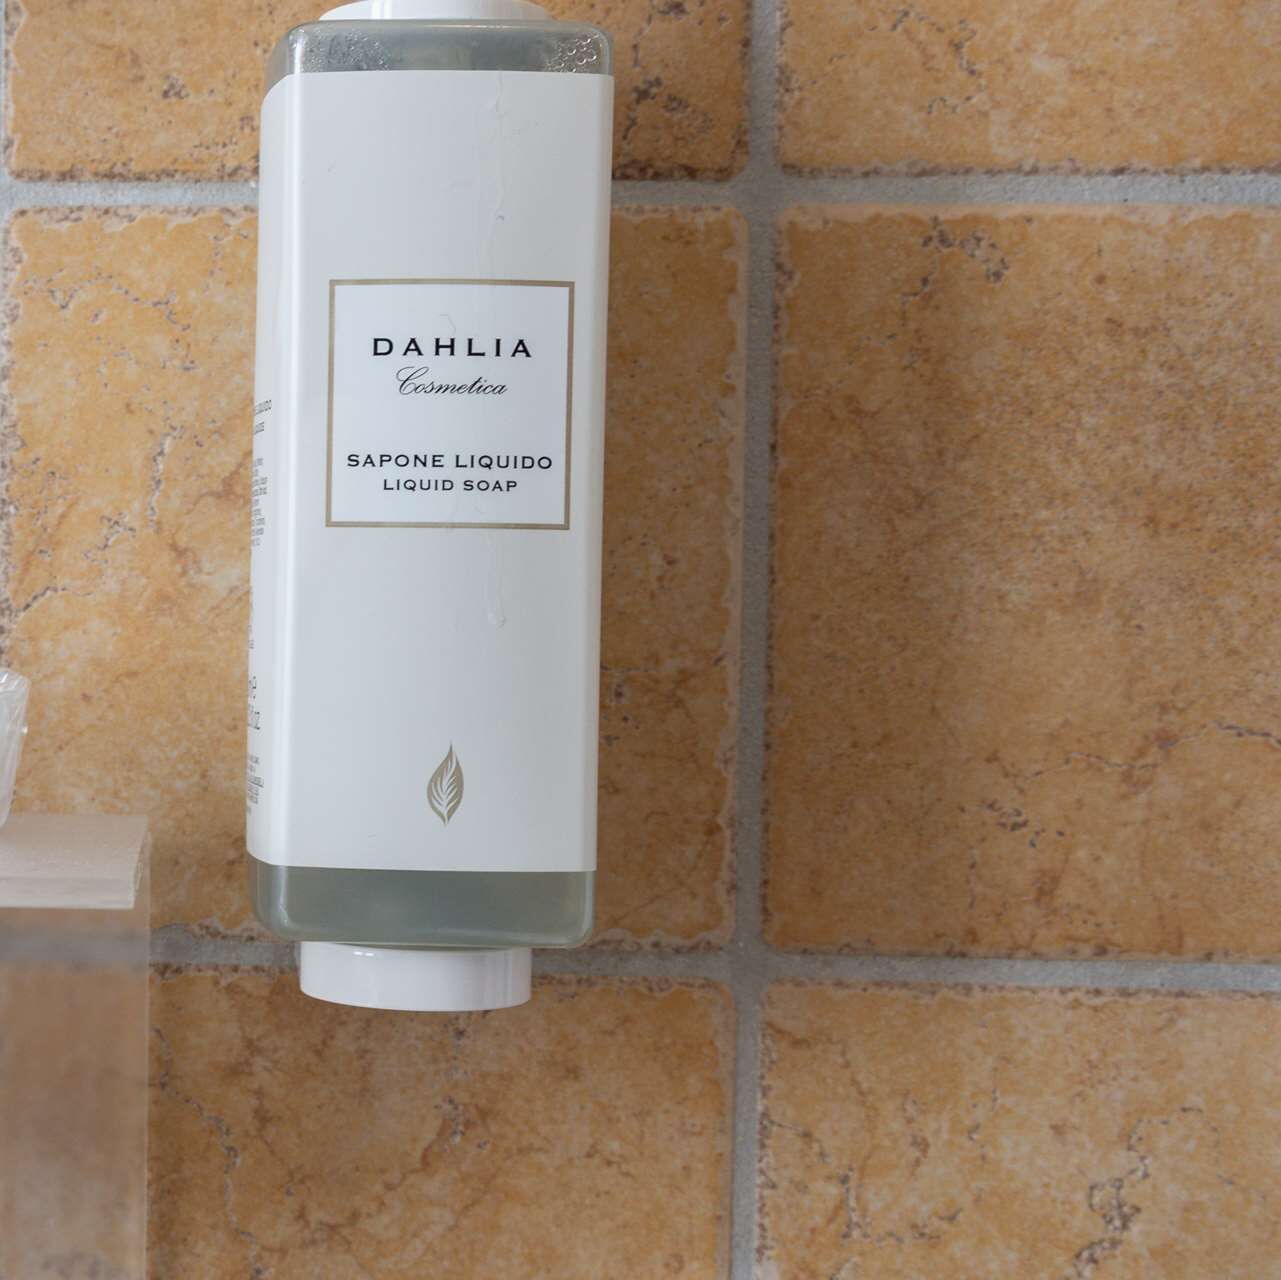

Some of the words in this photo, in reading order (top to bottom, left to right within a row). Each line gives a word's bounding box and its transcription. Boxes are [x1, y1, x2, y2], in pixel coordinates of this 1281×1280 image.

[372, 337, 532, 358] DAHLIA
[395, 366, 508, 396] Cosmetica
[346, 454, 445, 468] SAPONE
[455, 454, 553, 470] LIQUIDO
[383, 478, 455, 492] LIQUID
[463, 479, 518, 492] SOAP
